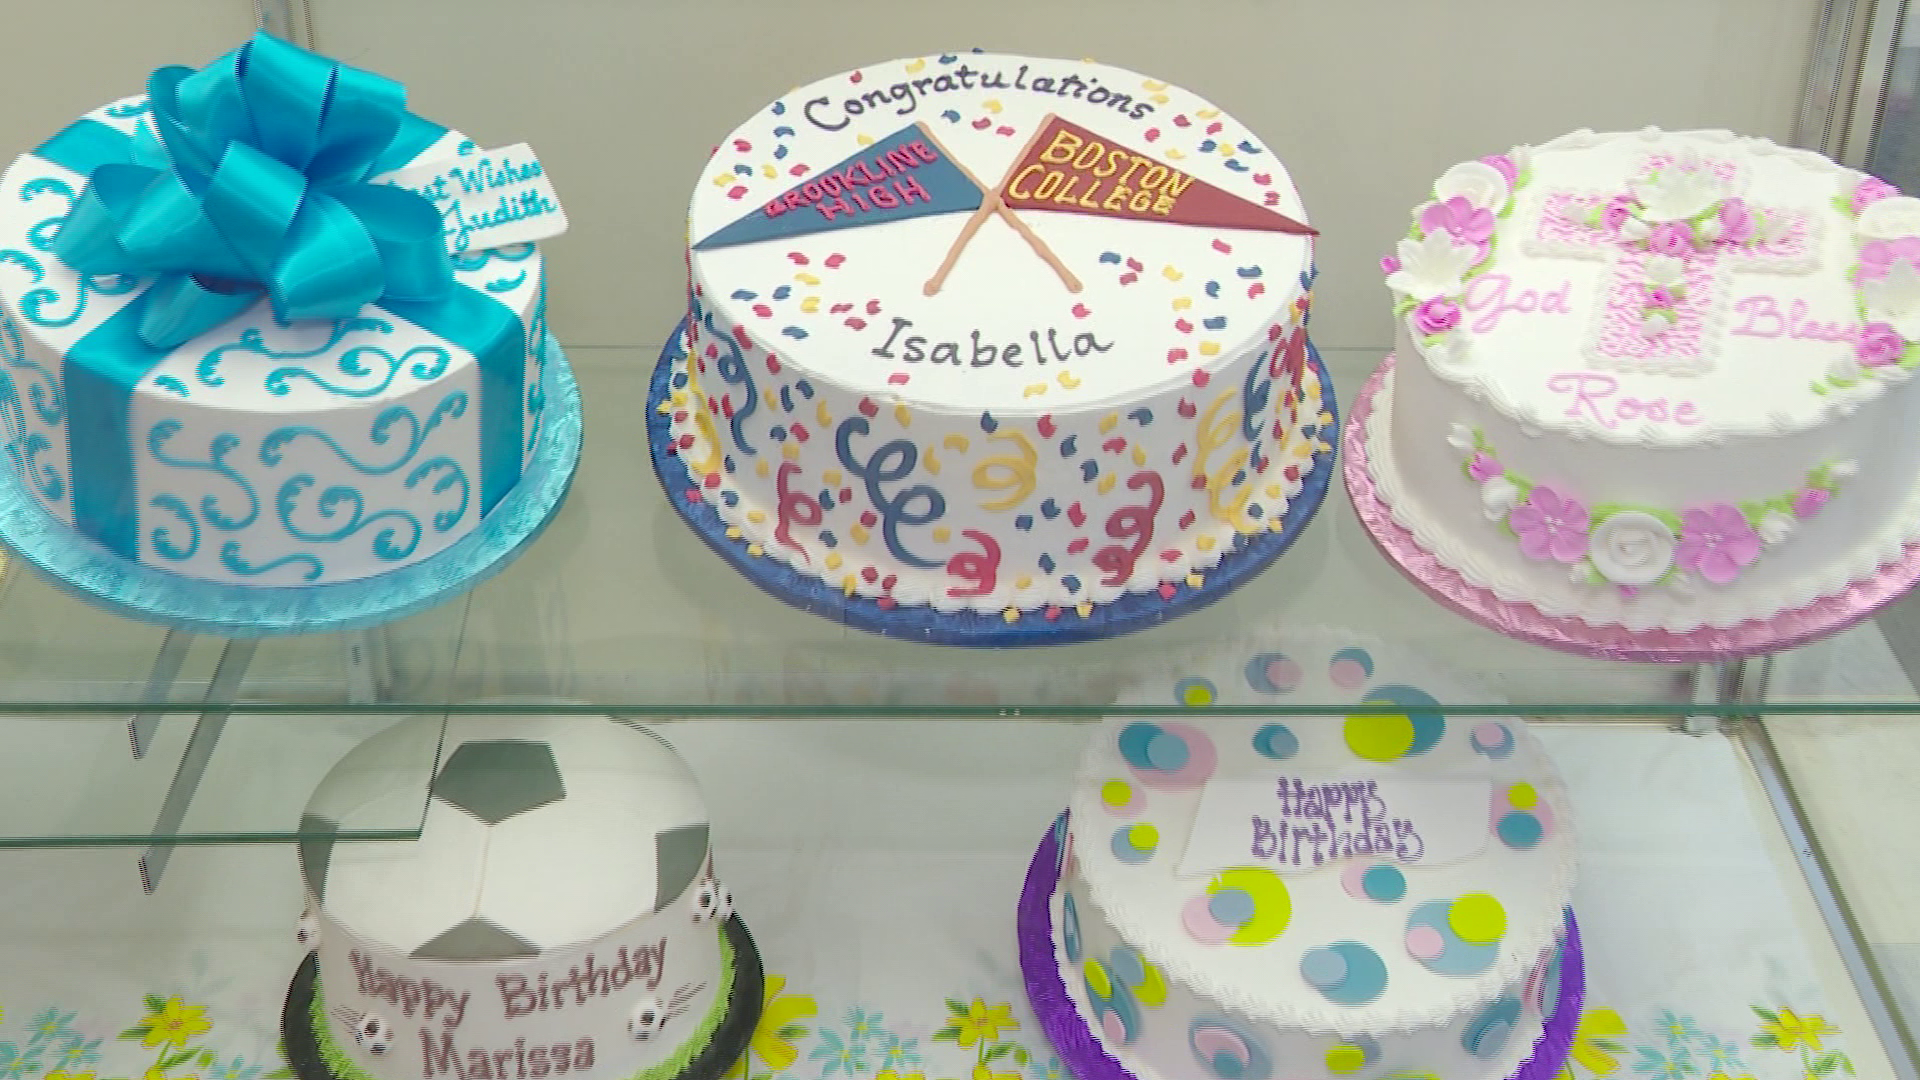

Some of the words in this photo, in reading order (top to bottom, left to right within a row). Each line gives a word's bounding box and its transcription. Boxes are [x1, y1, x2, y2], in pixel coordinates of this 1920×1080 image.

[804, 64, 1155, 131] Congratulations
[448, 157, 543, 194] Wishes
[764, 139, 938, 219] BROOKLINE
[1008, 164, 1177, 216] COLLEGE
[1039, 129, 1196, 199] BOSTON
[442, 188, 559, 252] Judith
[815, 175, 932, 221] HIGH
[1465, 274, 1572, 334] God
[871, 316, 1115, 368] Isabella
[1546, 372, 1705, 429] Rose
[1276, 776, 1387, 823] Happy
[1251, 814, 1426, 866] Birthday
[349, 948, 471, 1030] Happy
[495, 937, 668, 1020] Birthday
[418, 1026, 596, 1080] Marissa
